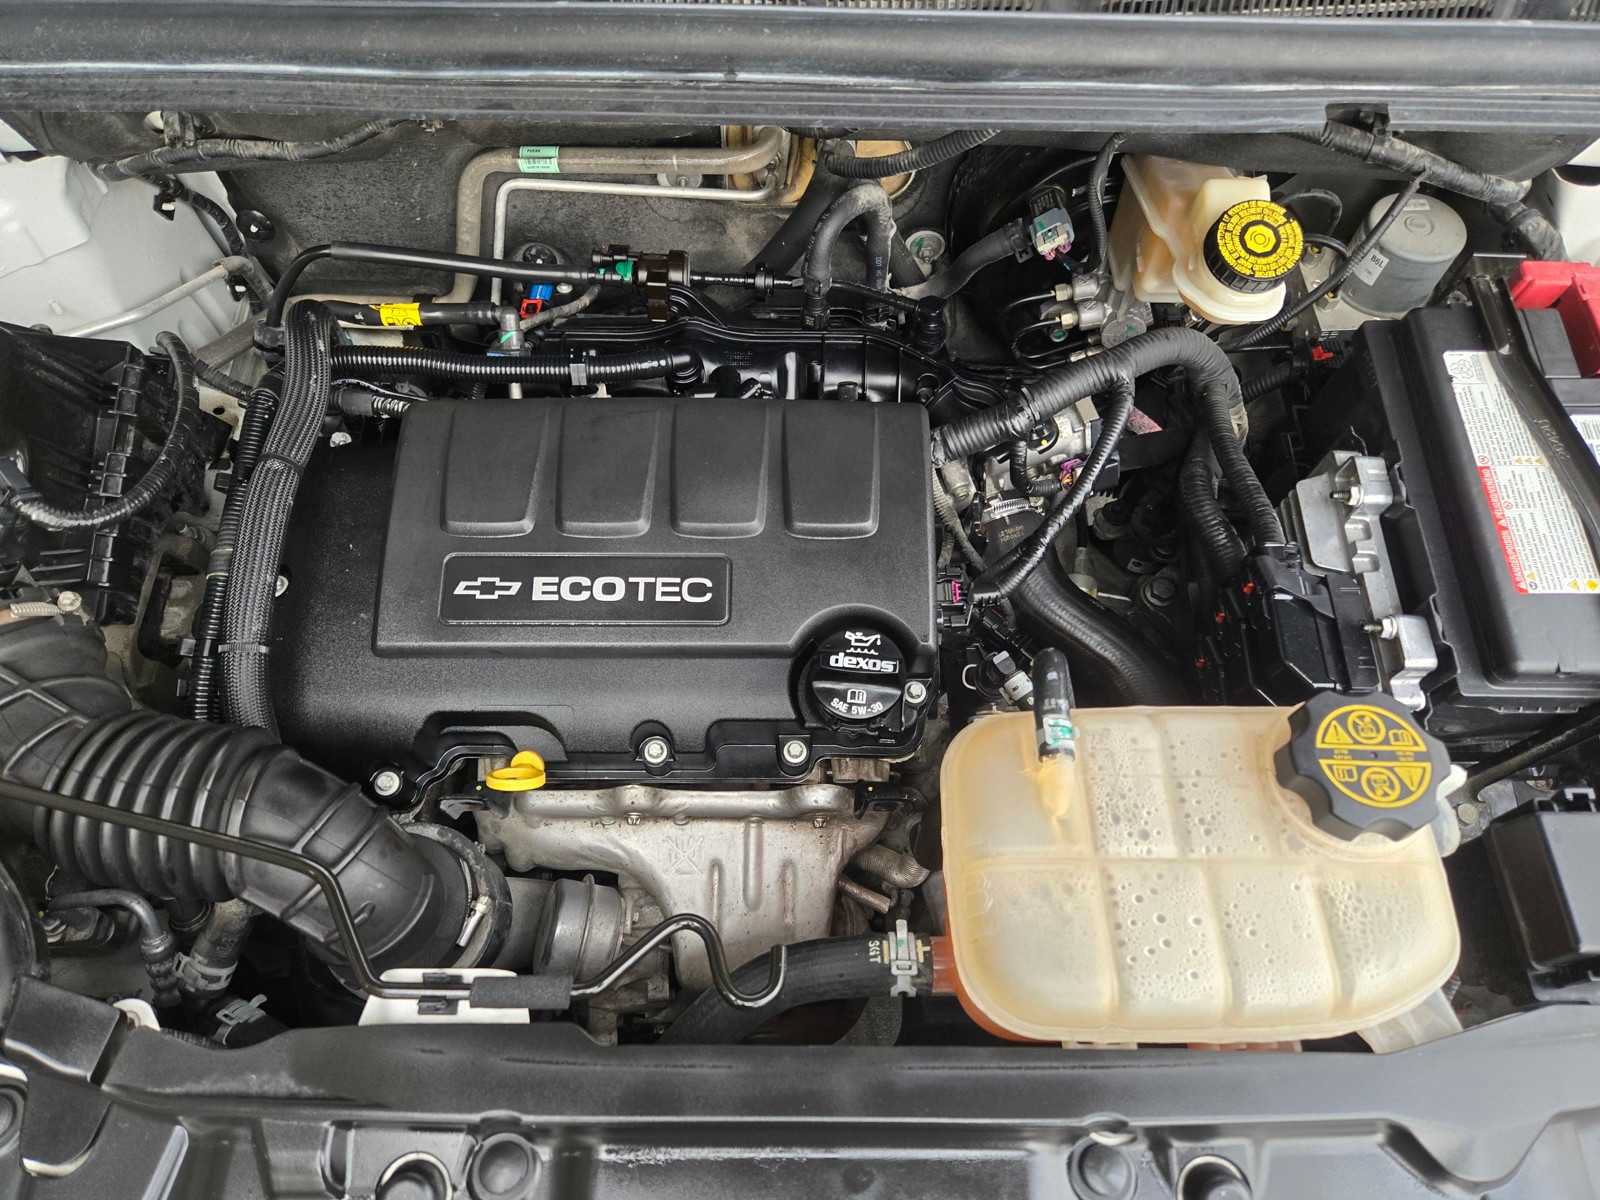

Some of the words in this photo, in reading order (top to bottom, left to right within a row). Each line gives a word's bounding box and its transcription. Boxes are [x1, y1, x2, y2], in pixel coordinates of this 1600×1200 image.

[532, 576, 713, 602] ECOTEC
[829, 652, 896, 672] dexos
[830, 697, 849, 712] SAE
[851, 701, 883, 715] 5W-30
